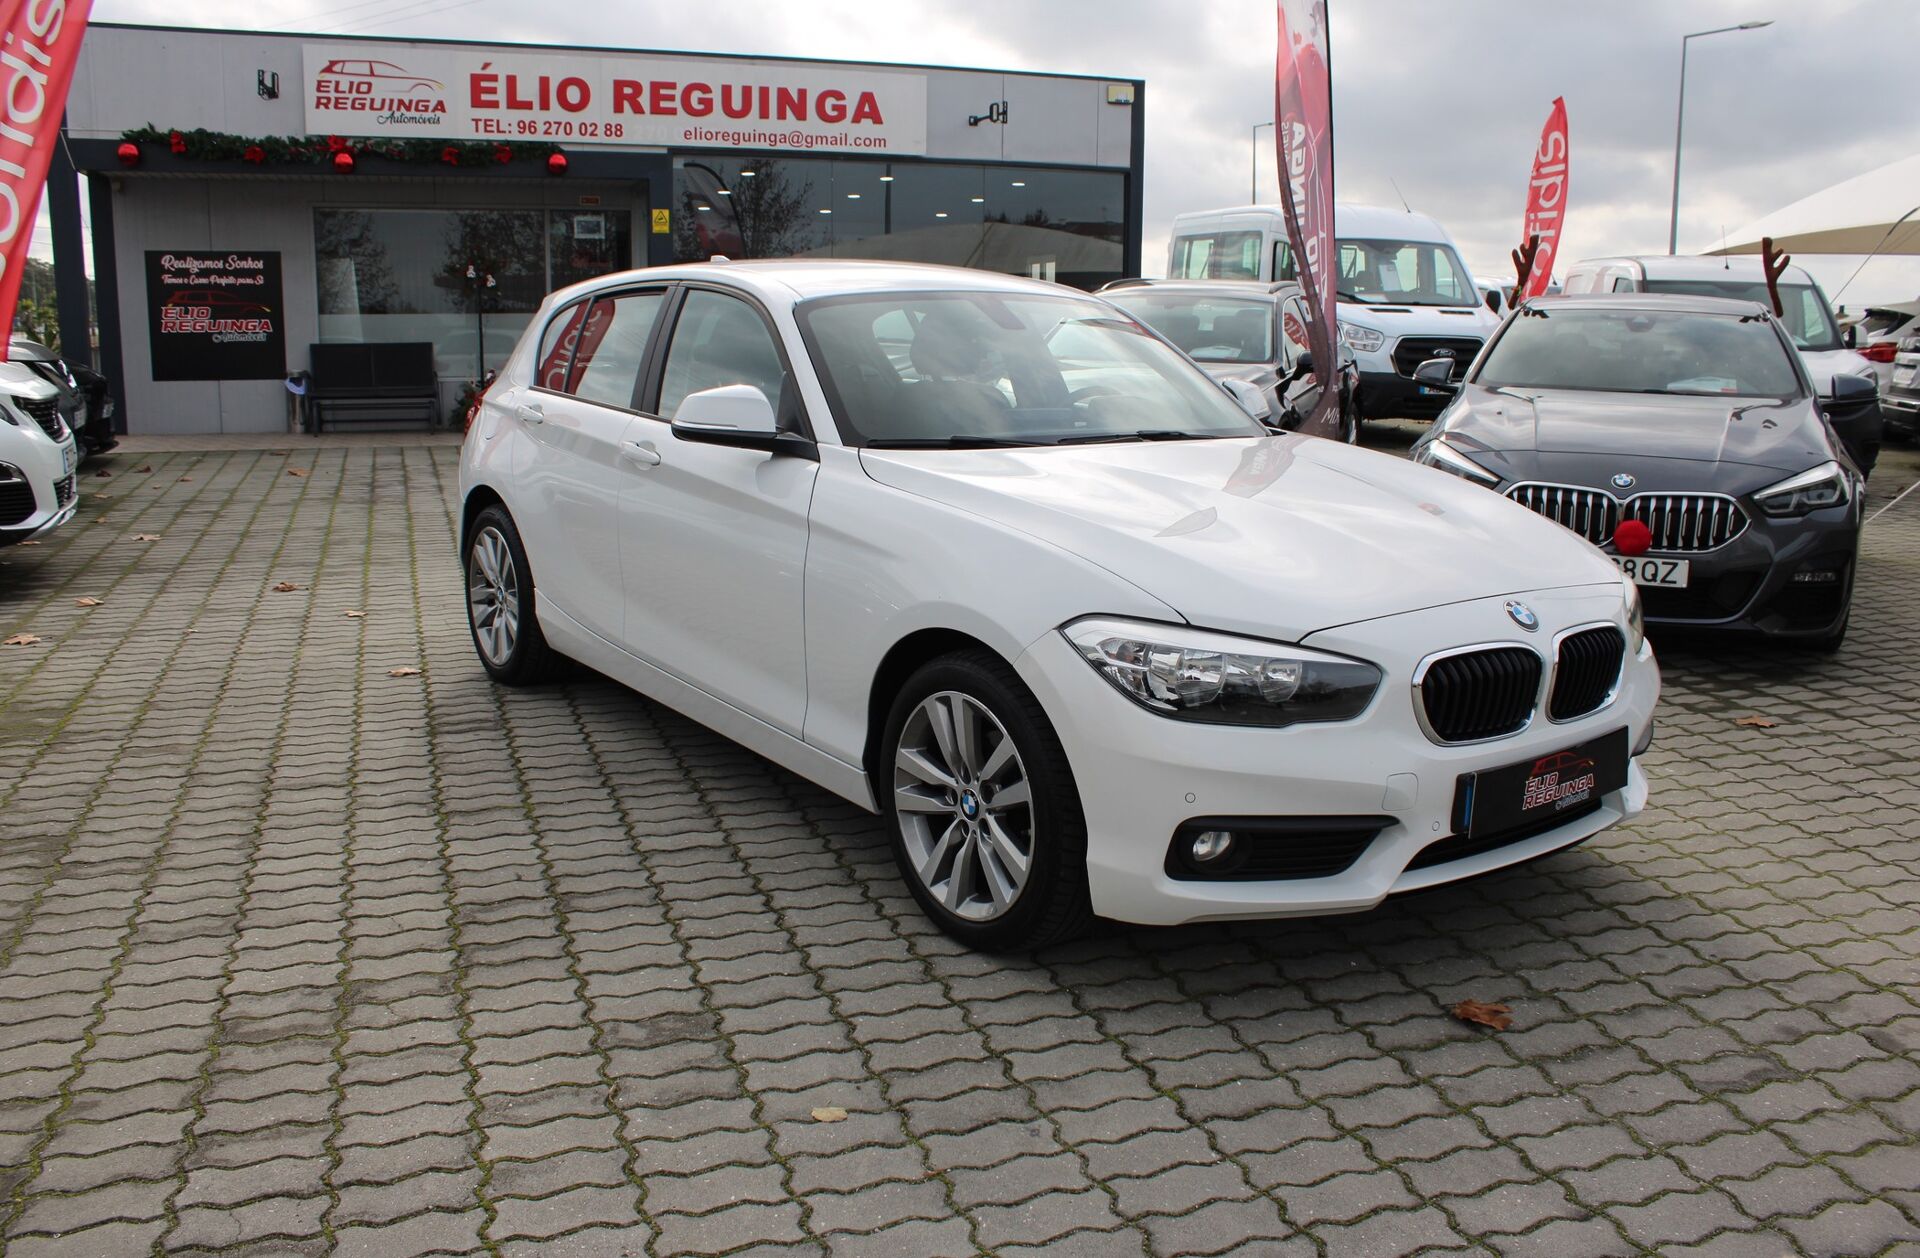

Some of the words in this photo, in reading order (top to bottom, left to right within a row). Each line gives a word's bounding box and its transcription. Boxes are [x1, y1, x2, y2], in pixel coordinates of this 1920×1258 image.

[469, 62, 592, 112] ÉLIO
[612, 79, 884, 125] REGUINGA
[314, 96, 447, 113] REGUINGA
[377, 111, 441, 125] Automóveis
[471, 118, 512, 134] TEL:
[517, 120, 537, 135] 96
[543, 121, 573, 136] 270
[579, 122, 598, 137] 02
[604, 123, 624, 137] 88
[683, 127, 887, 148] elioreguinga@gmail.com
[161, 254, 223, 273] Realizamos
[225, 254, 264, 270] Sonhos
[161, 319, 273, 333] REGUINGA
[1522, 773, 1595, 811] REGUINGA
